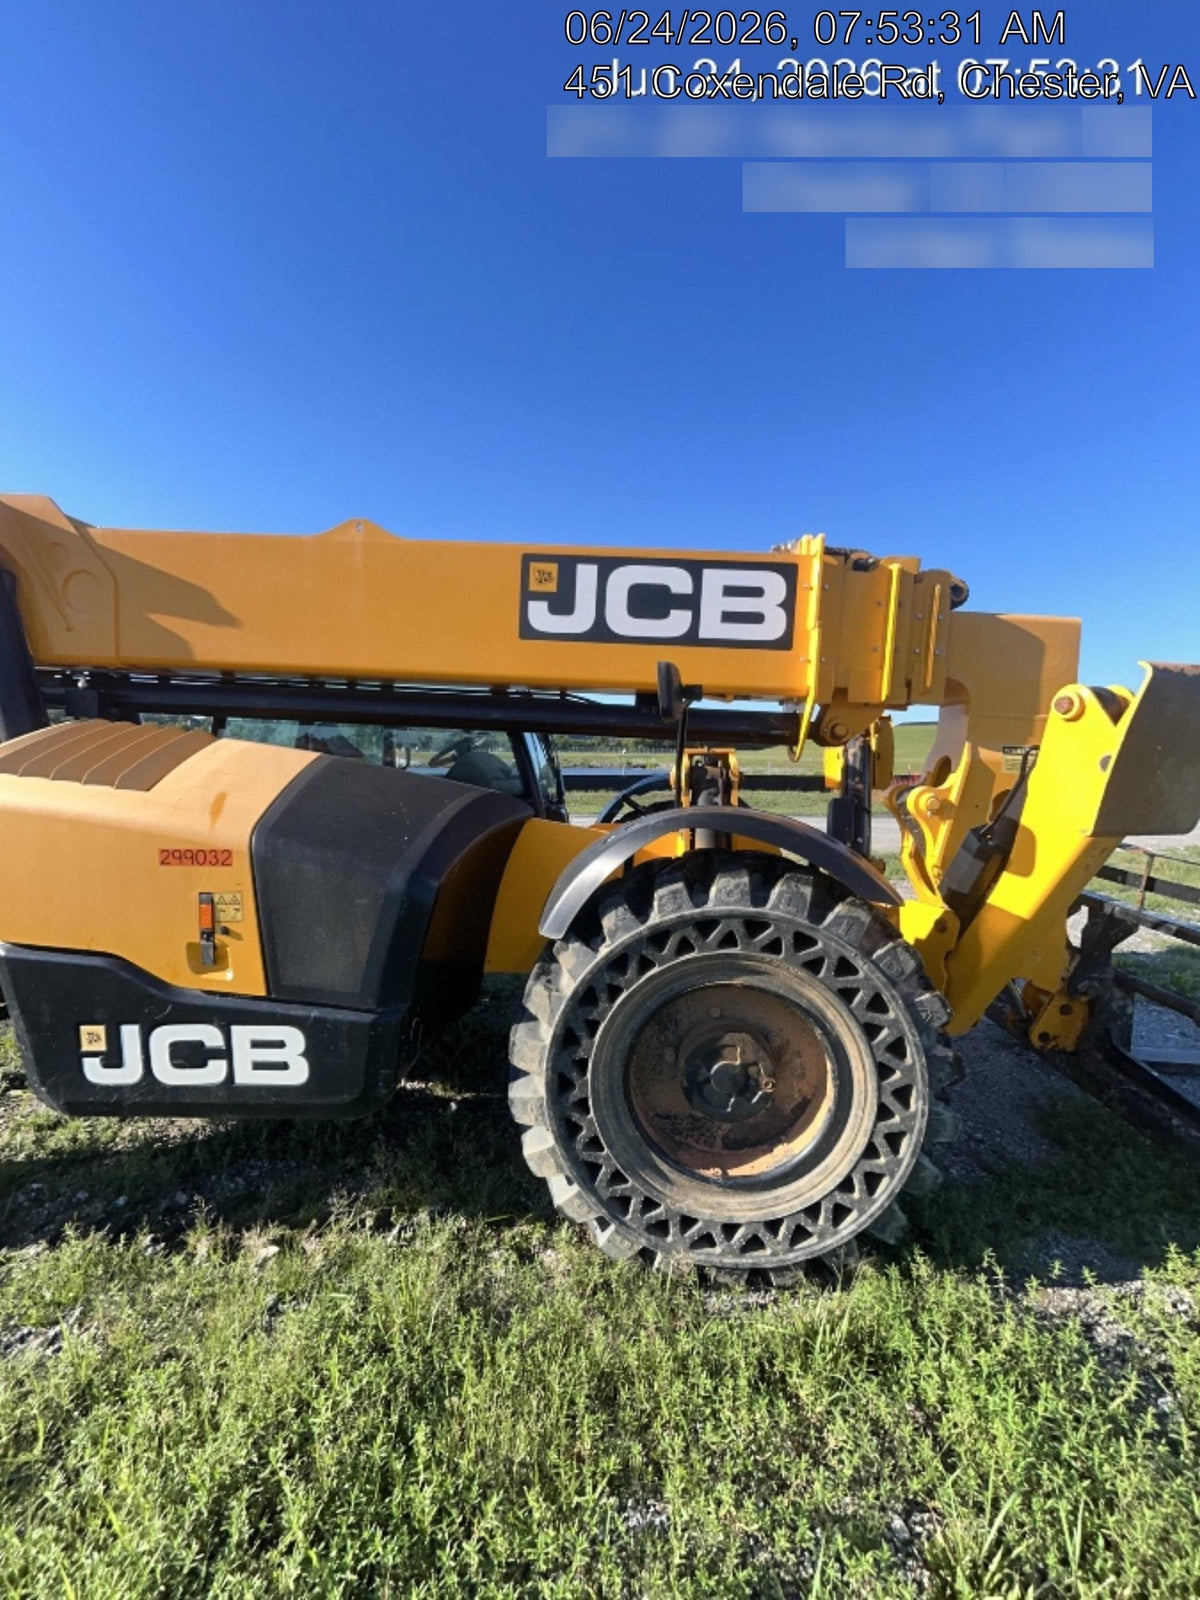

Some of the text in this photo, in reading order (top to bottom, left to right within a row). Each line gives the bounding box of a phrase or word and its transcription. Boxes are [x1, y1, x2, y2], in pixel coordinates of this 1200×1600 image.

[527, 563, 787, 641] JCB
[160, 849, 232, 866] 299032
[81, 1023, 309, 1086] JCB
